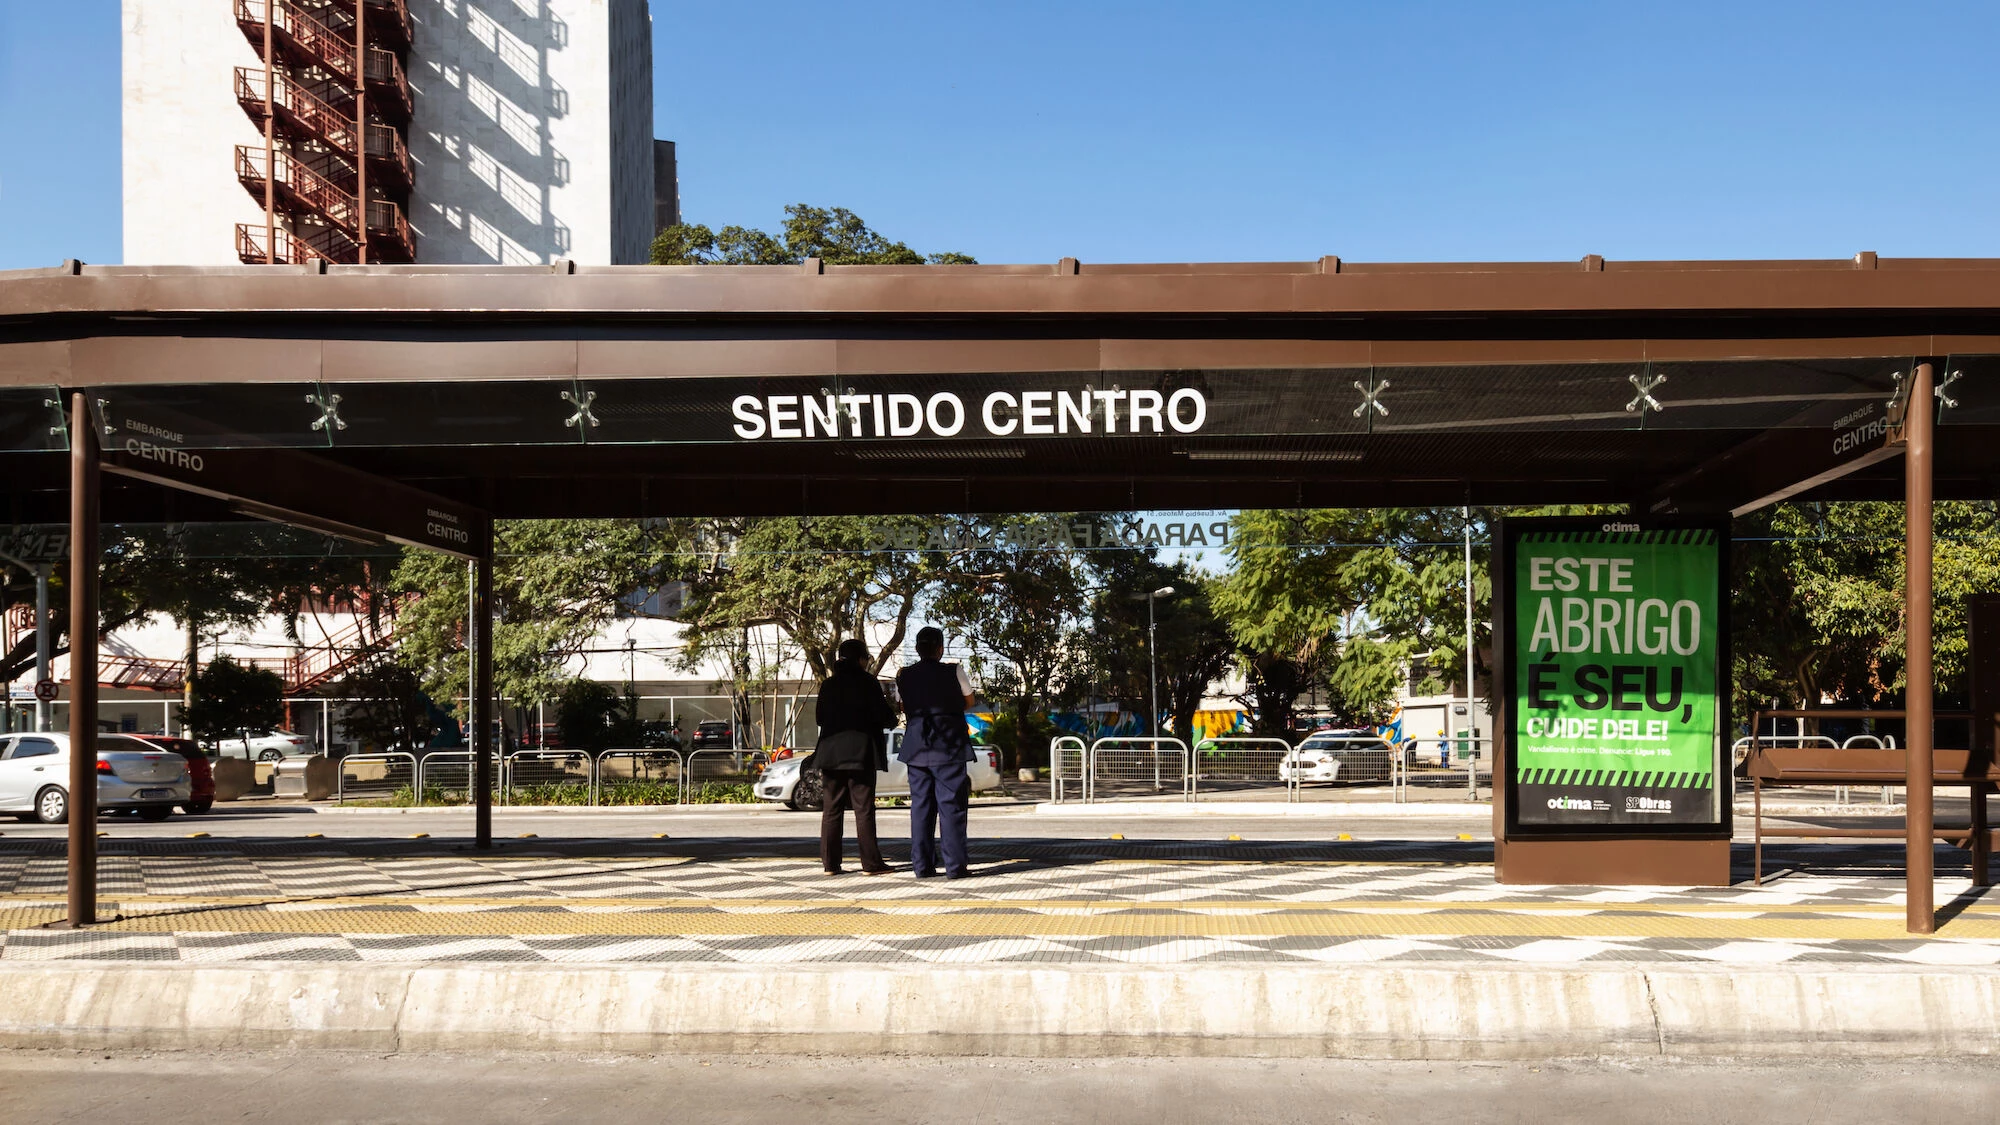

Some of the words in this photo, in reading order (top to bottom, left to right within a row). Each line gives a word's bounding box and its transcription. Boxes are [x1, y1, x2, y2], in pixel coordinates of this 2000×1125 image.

[731, 392, 966, 440] SENTIDO
[982, 388, 1207, 436] CENTRO
[1833, 403, 1873, 431] EMBARQUE
[126, 419, 183, 443] EMBARQUE
[1833, 416, 1888, 455] CENTRO
[126, 438, 203, 472] CENTRO
[427, 522, 468, 544] CENTRO
[1602, 522, 1641, 533] otima
[1530, 557, 1634, 592] ESTE
[1528, 597, 1701, 656] ABRIGO
[1527, 652, 1561, 709] É
[1573, 664, 1693, 724] SEU,
[1526, 717, 1598, 740] CUIDE
[1602, 719, 1669, 741] DELE!
[1527, 745, 1569, 753] Vandalismo
[1635, 747, 1656, 757] Ligue
[1547, 796, 1593, 811] otima
[1625, 796, 1672, 810] SPObras
